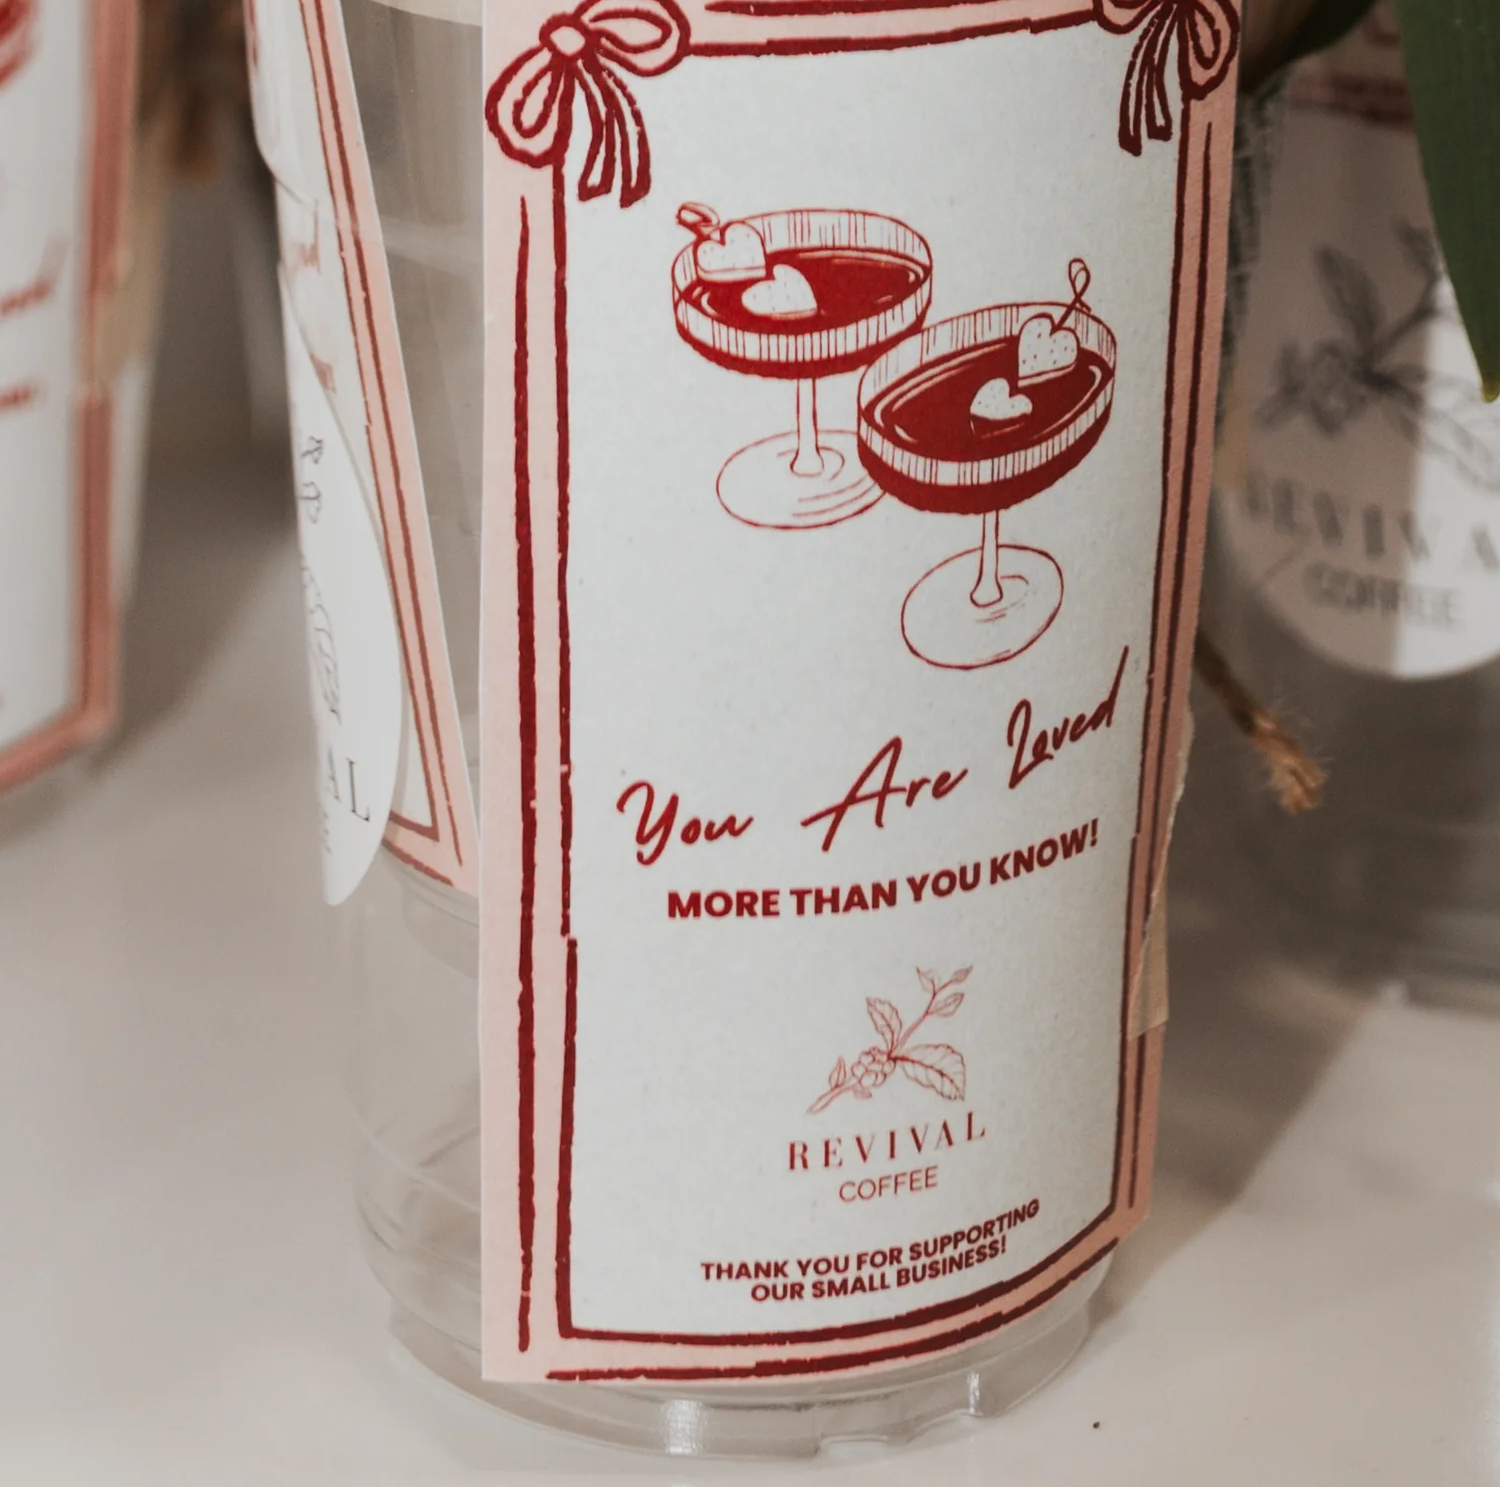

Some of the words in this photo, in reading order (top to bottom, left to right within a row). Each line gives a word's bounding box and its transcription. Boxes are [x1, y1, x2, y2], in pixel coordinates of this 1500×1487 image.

[616, 781, 755, 867] You
[801, 736, 968, 853] Are
[1007, 645, 1130, 790] Loved
[667, 889, 780, 919] MORE
[790, 879, 897, 914] THAN
[906, 861, 982, 903] YOU
[989, 817, 1099, 886] KNOW!
[788, 1111, 986, 1171] REVIVAL
[838, 1165, 939, 1203] COFFEE
[701, 1260, 790, 1281] THANK
[796, 1255, 850, 1277] YOU
[856, 1246, 903, 1271] FOR
[908, 1198, 1040, 1261] SUPPORTING
[750, 1284, 805, 1303] OUR
[811, 1275, 890, 1299] SMALL
[896, 1233, 1007, 1288] BUSINESS!
